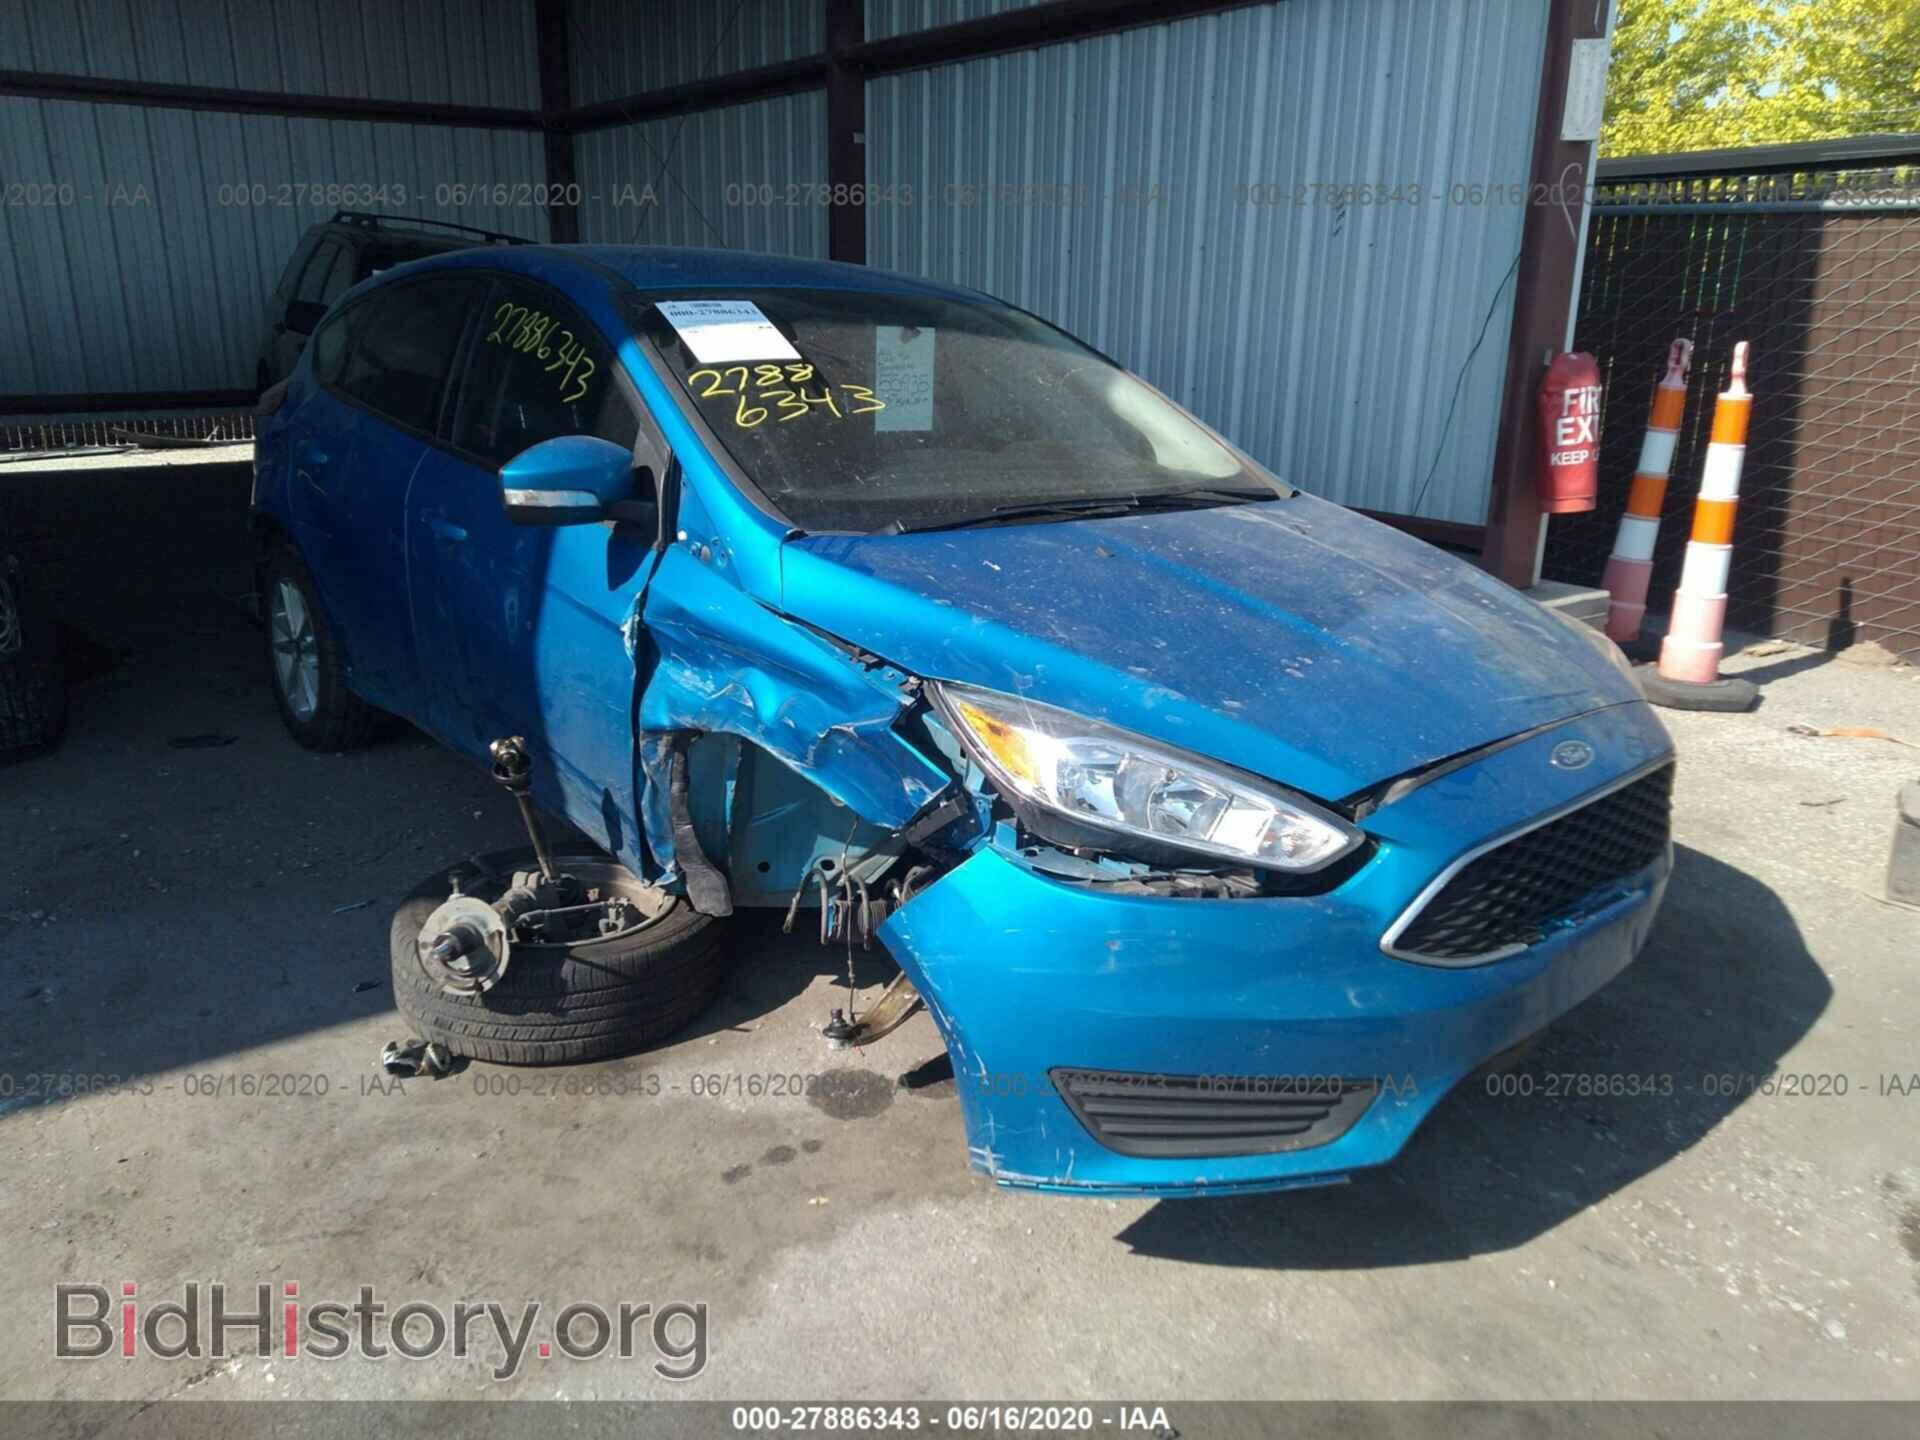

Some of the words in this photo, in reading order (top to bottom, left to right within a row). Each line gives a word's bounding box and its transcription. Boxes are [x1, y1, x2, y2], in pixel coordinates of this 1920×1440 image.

[688, 363, 814, 397] 2788
[735, 385, 886, 427] 6343
[1551, 450, 1589, 466] KEEP
